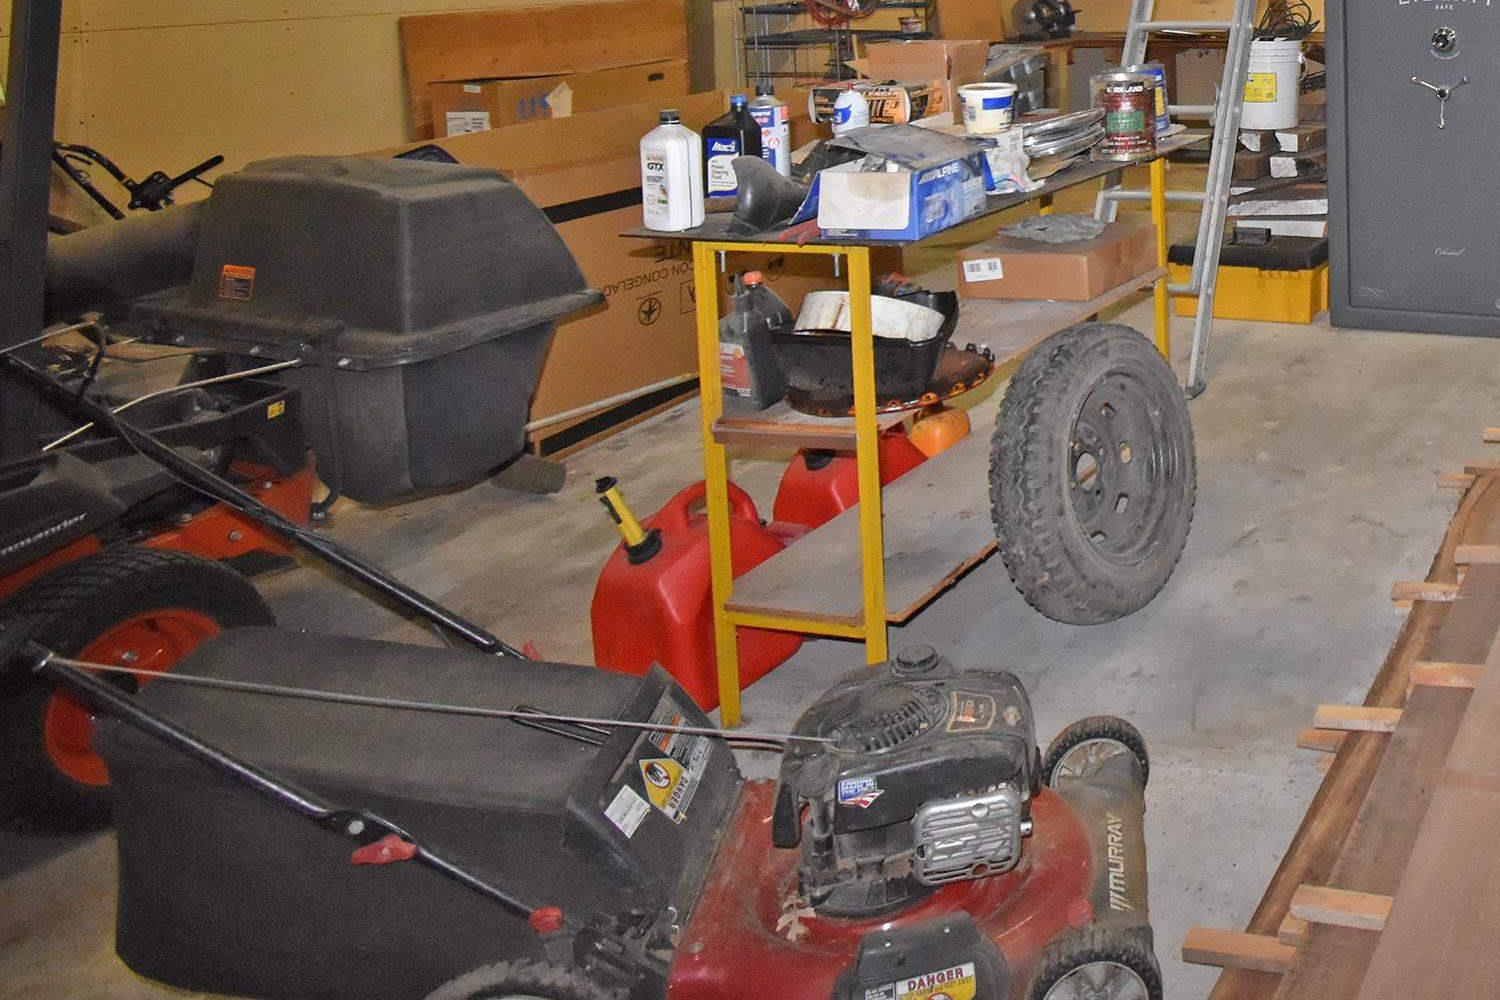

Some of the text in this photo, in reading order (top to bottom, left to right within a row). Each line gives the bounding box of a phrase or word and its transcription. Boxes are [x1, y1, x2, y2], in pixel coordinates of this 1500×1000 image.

[646, 162, 664, 171] GTX
[669, 776, 689, 810] DANGER
[1106, 812, 1128, 897] MURRAY
[907, 967, 964, 992] DANGER
